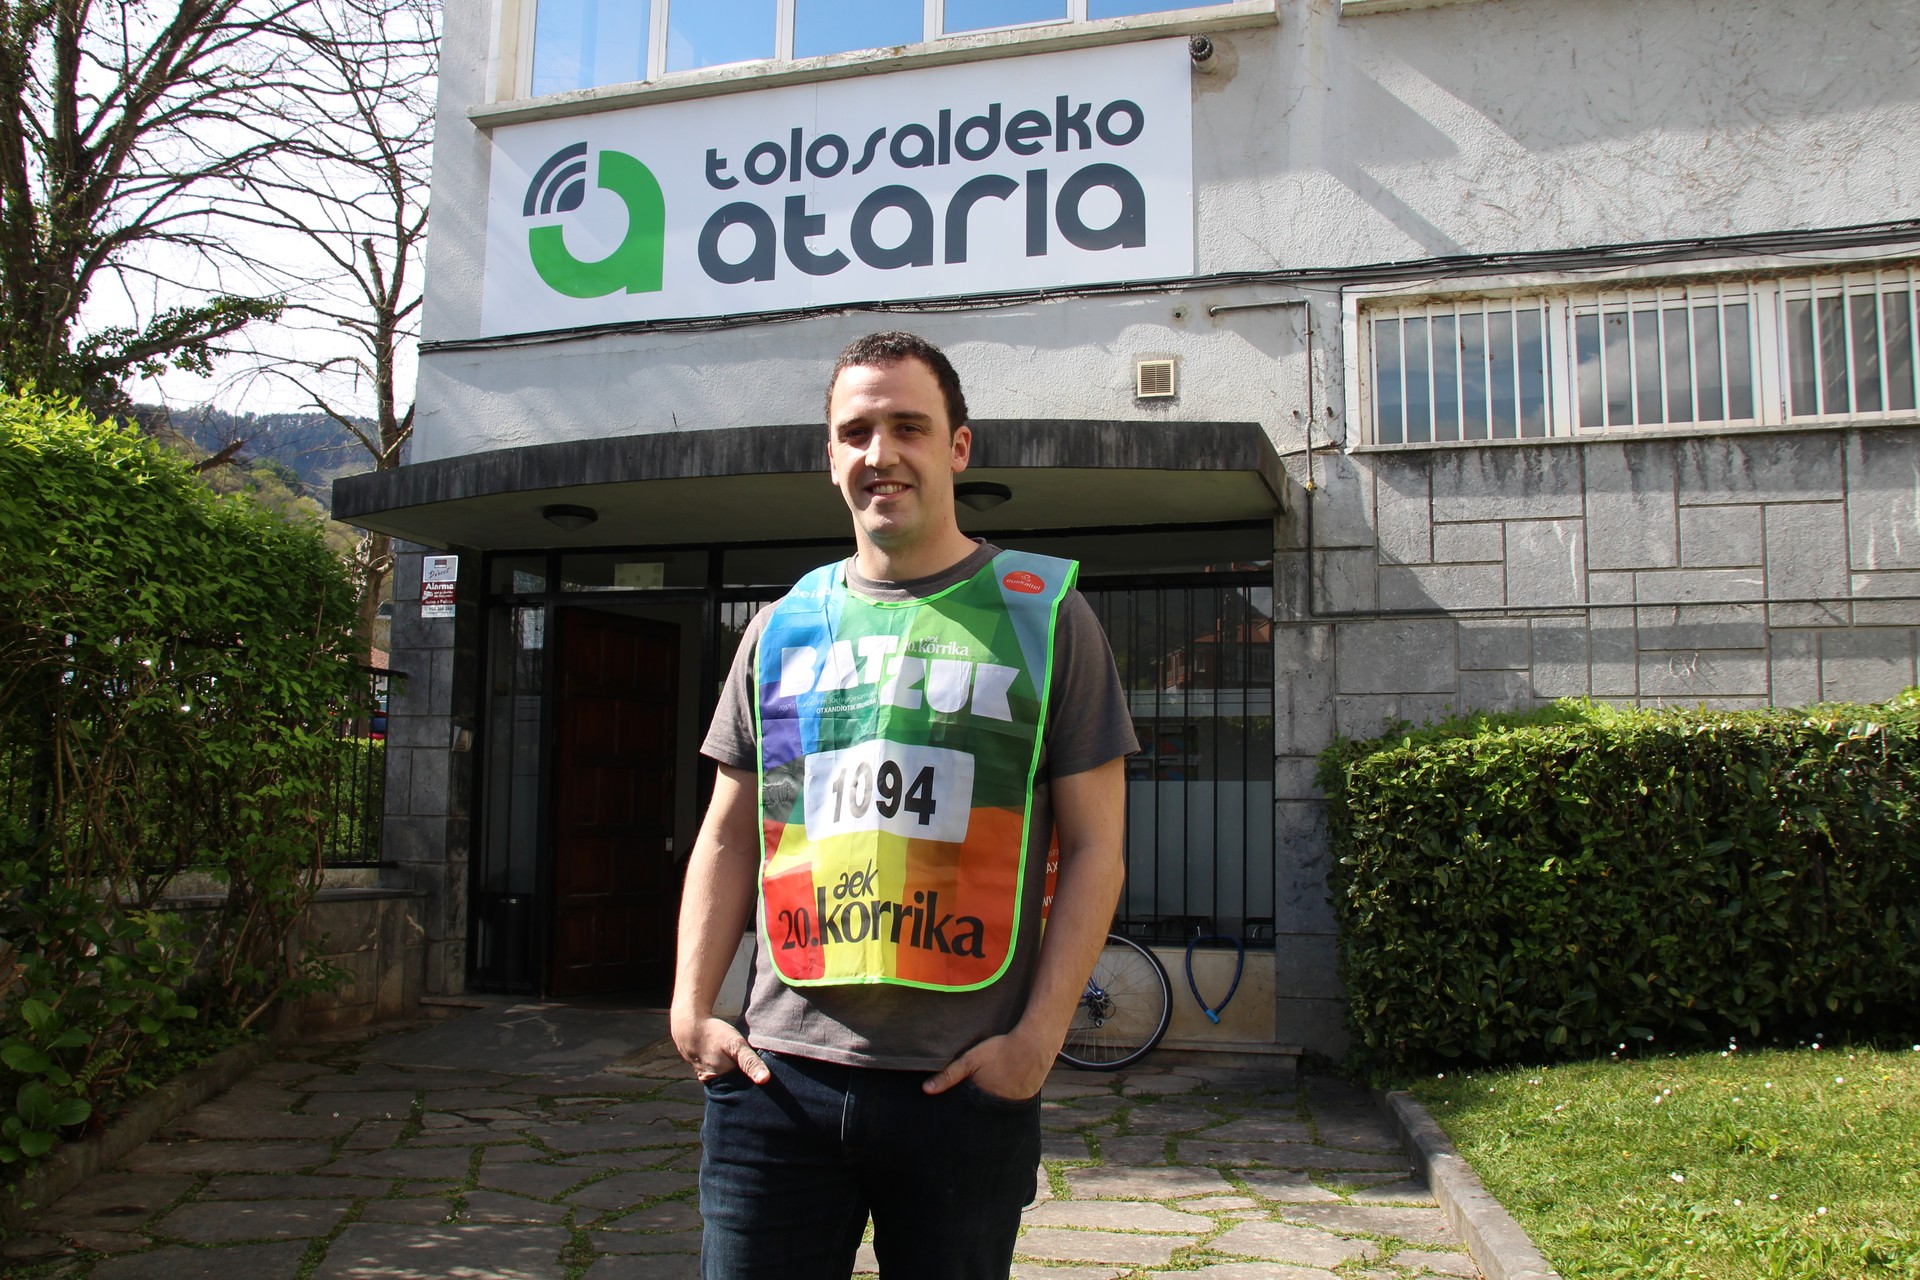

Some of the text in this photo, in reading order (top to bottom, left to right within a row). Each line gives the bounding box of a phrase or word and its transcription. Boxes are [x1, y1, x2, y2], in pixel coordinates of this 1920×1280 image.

[704, 94, 1145, 190] tolosaldeko
[697, 162, 1147, 285] ataria
[779, 634, 1021, 722] BATZUK
[918, 637, 970, 657] korrika
[832, 759, 937, 826] 1094
[832, 858, 879, 899] aek
[817, 886, 986, 959] korrika
